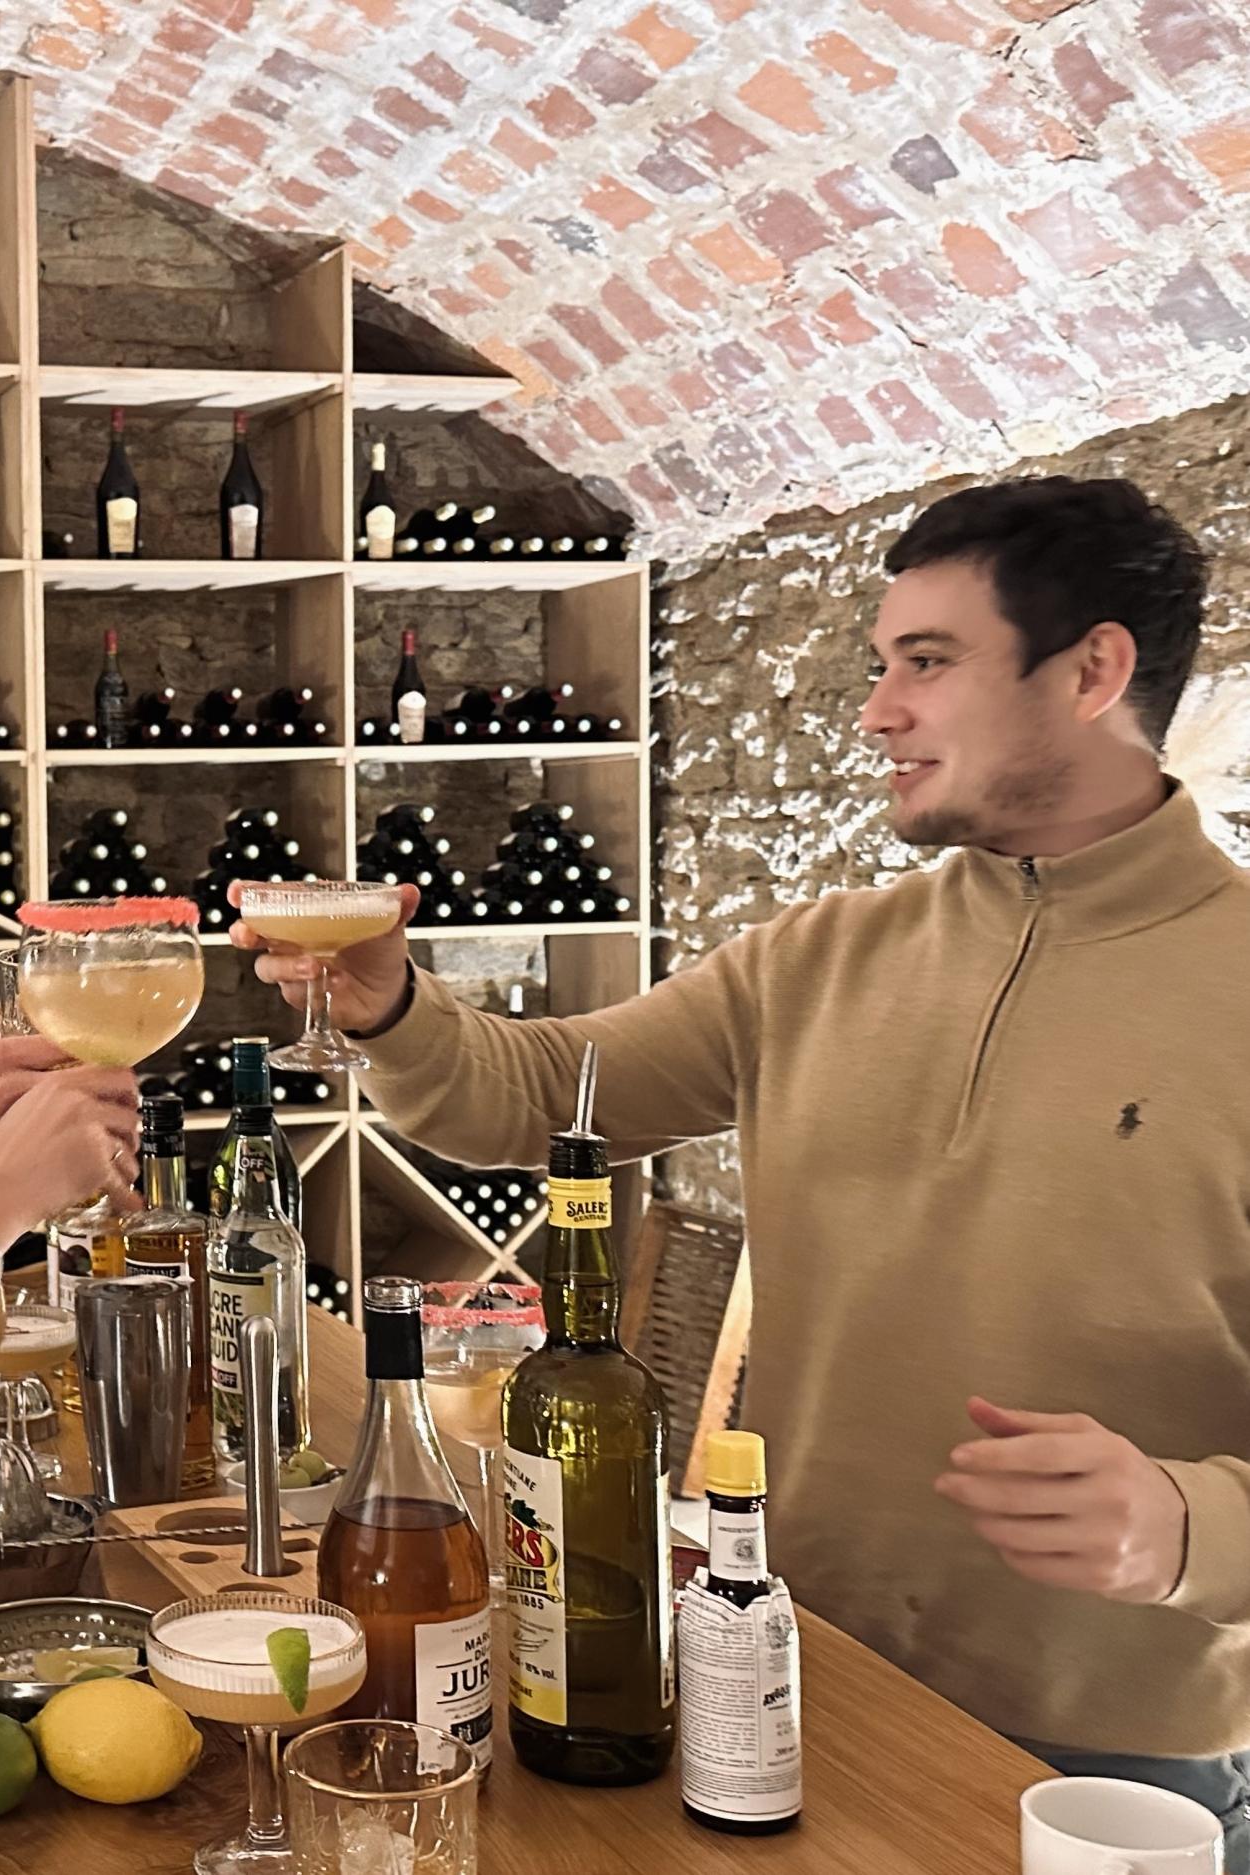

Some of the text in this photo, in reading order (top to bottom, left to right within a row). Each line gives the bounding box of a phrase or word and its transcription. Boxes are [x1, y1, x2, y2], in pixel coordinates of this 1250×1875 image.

[241, 1156, 264, 1169] OFF
[210, 1289, 243, 1316] CRE
[520, 1594, 544, 1610] 1885
[443, 1659, 489, 1697] JUR
